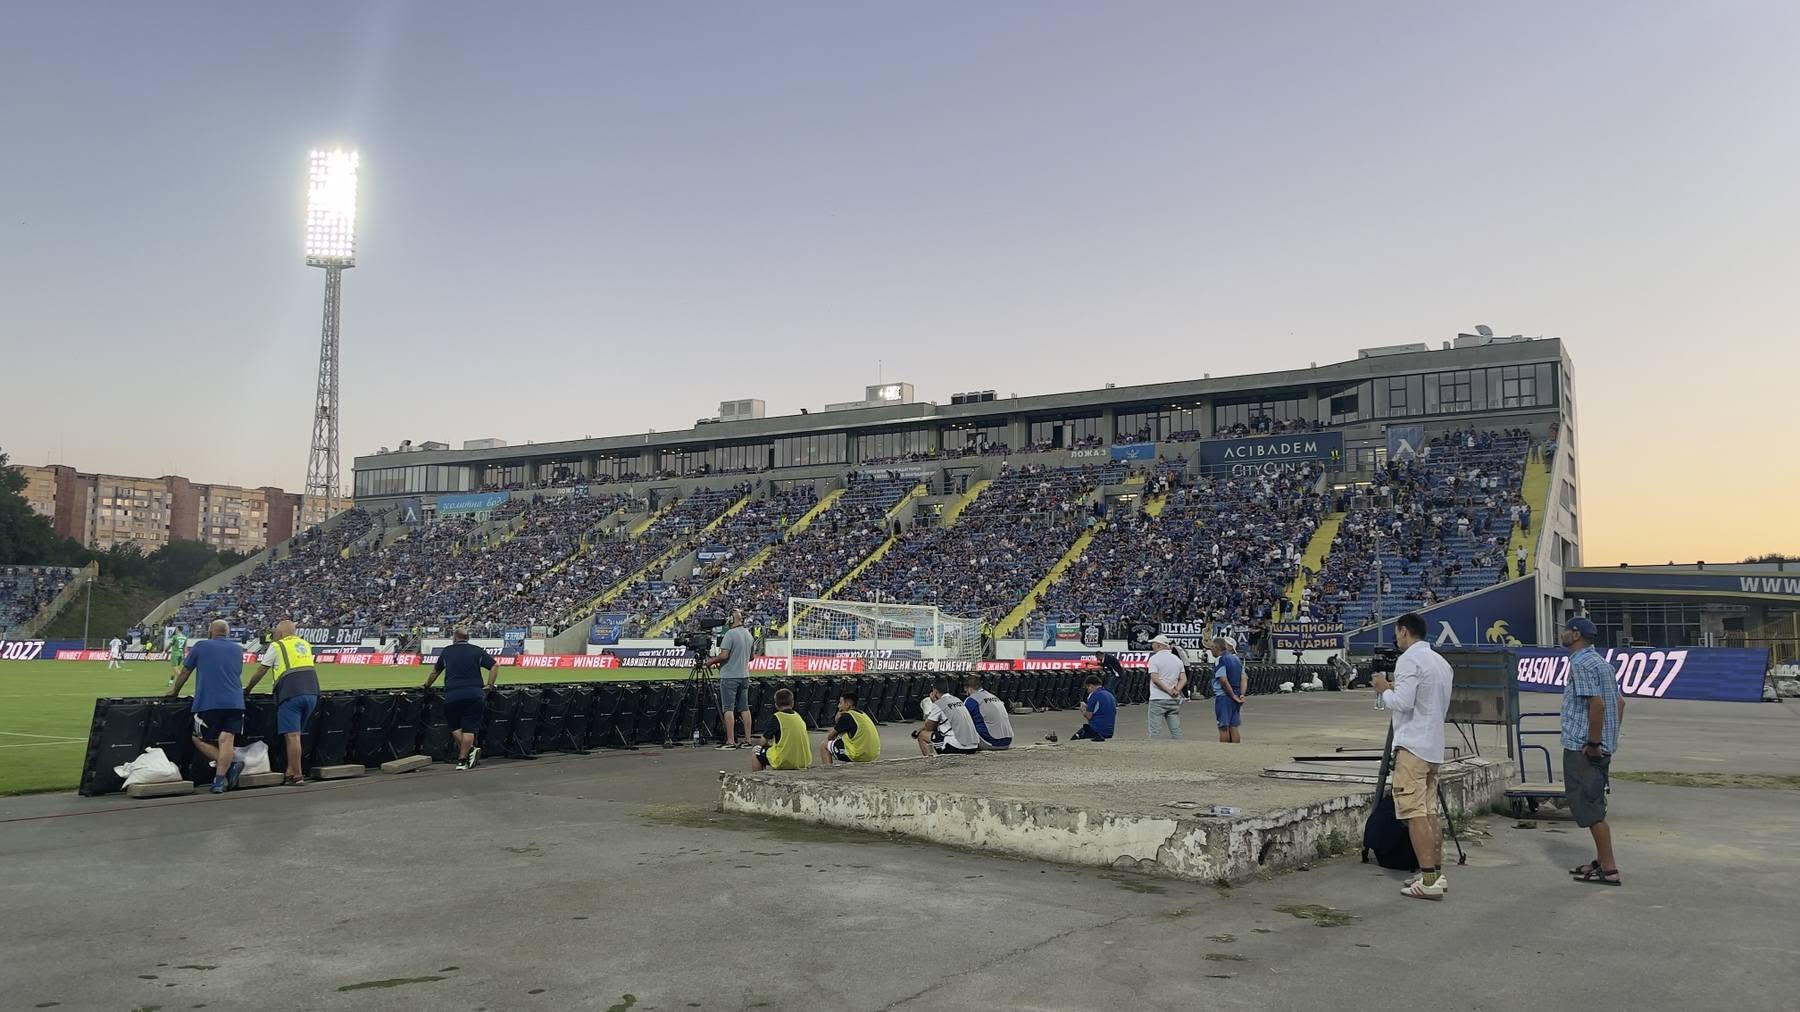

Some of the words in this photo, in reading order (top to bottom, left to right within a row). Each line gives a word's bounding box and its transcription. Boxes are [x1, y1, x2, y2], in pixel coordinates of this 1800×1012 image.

[1071, 449, 1100, 458] ЛОЖА
[1224, 441, 1318, 458] ACIBADEM
[1161, 622, 1201, 634] ULTRAS
[1272, 623, 1344, 633] ШАМПИОНИ
[336, 628, 363, 643] ВЪН!
[1277, 638, 1337, 649] БЪЛГАРИЯ
[340, 653, 372, 664] WINBET
[522, 656, 560, 667] WINBET
[573, 656, 614, 668] WINBET
[622, 657, 657, 667] ЗАВИШЕНИ
[807, 658, 857, 671] WINBET
[912, 660, 972, 671] КОЕФЦИЕНТИ
[1517, 656, 1558, 685] SEASON
